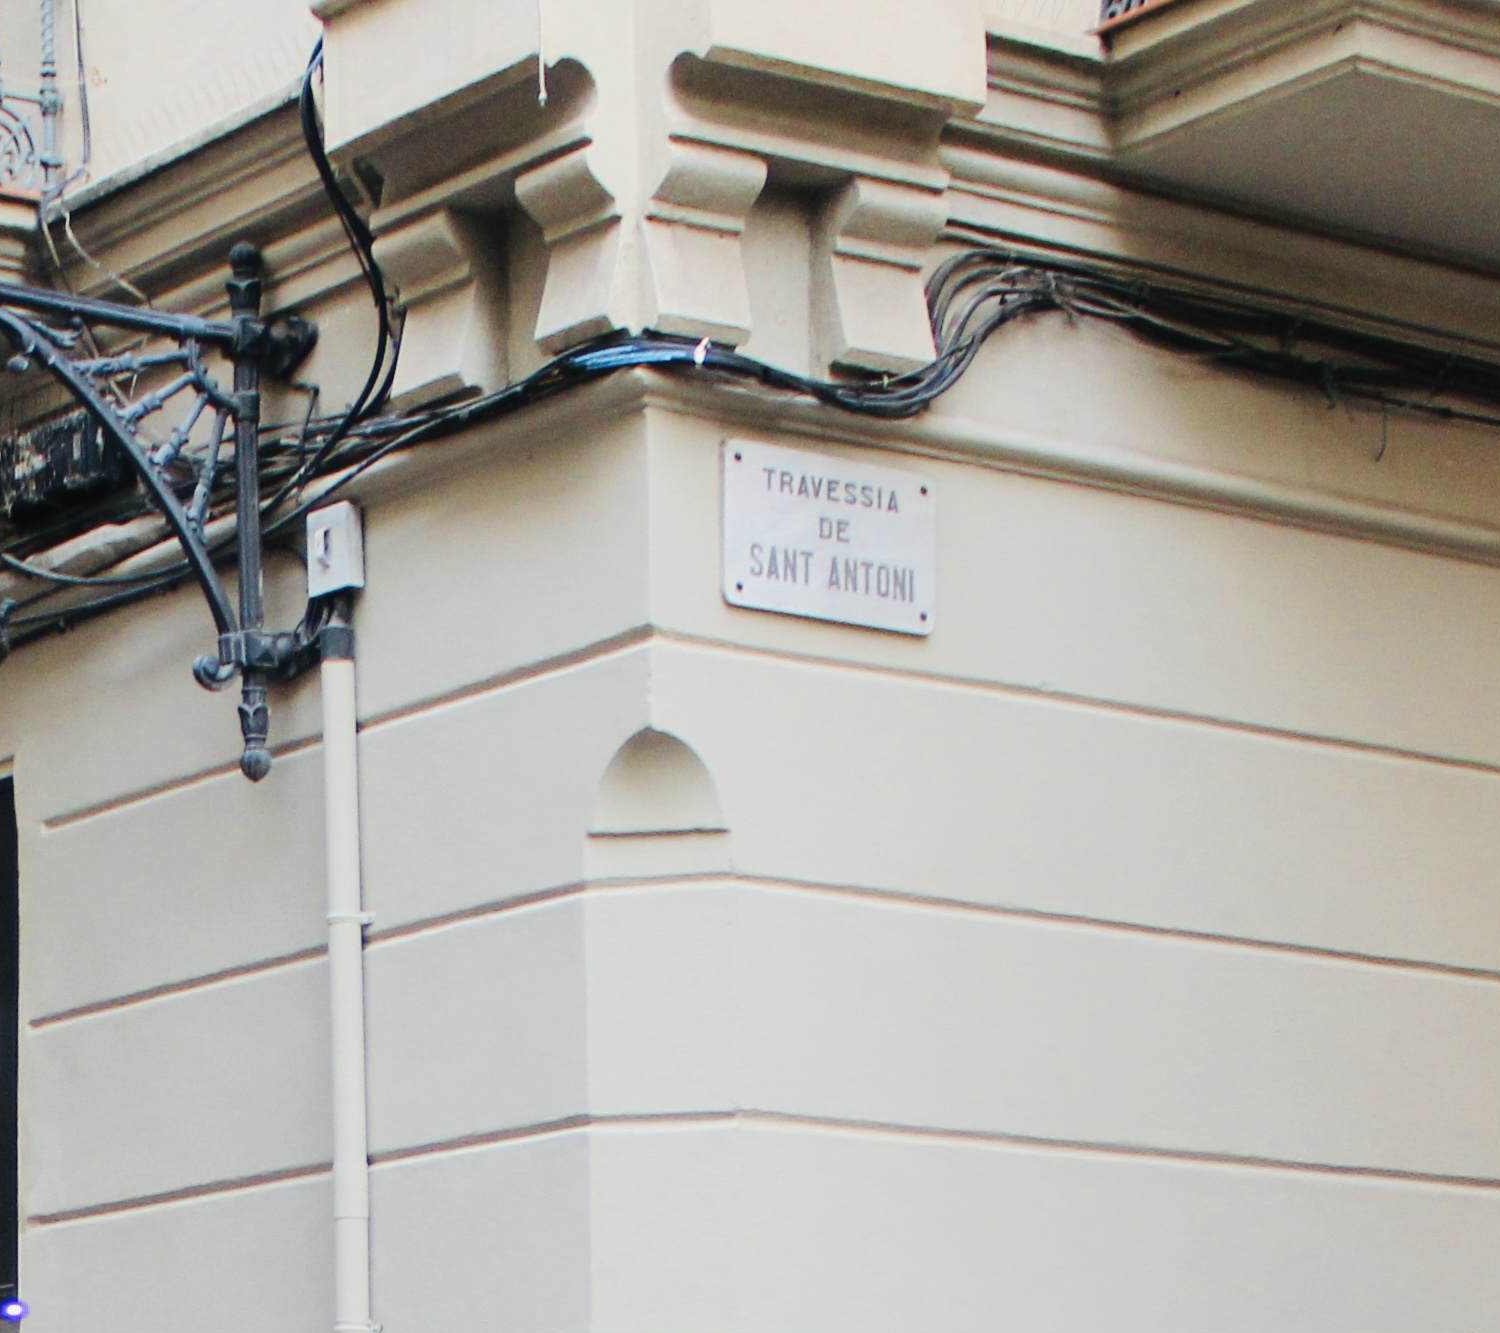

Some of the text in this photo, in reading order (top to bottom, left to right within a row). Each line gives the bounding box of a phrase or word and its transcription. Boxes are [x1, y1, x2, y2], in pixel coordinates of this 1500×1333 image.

[762, 467, 900, 514] TRAVESSIA
[818, 516, 851, 543] DE
[750, 543, 916, 603] SANT ANTONI
